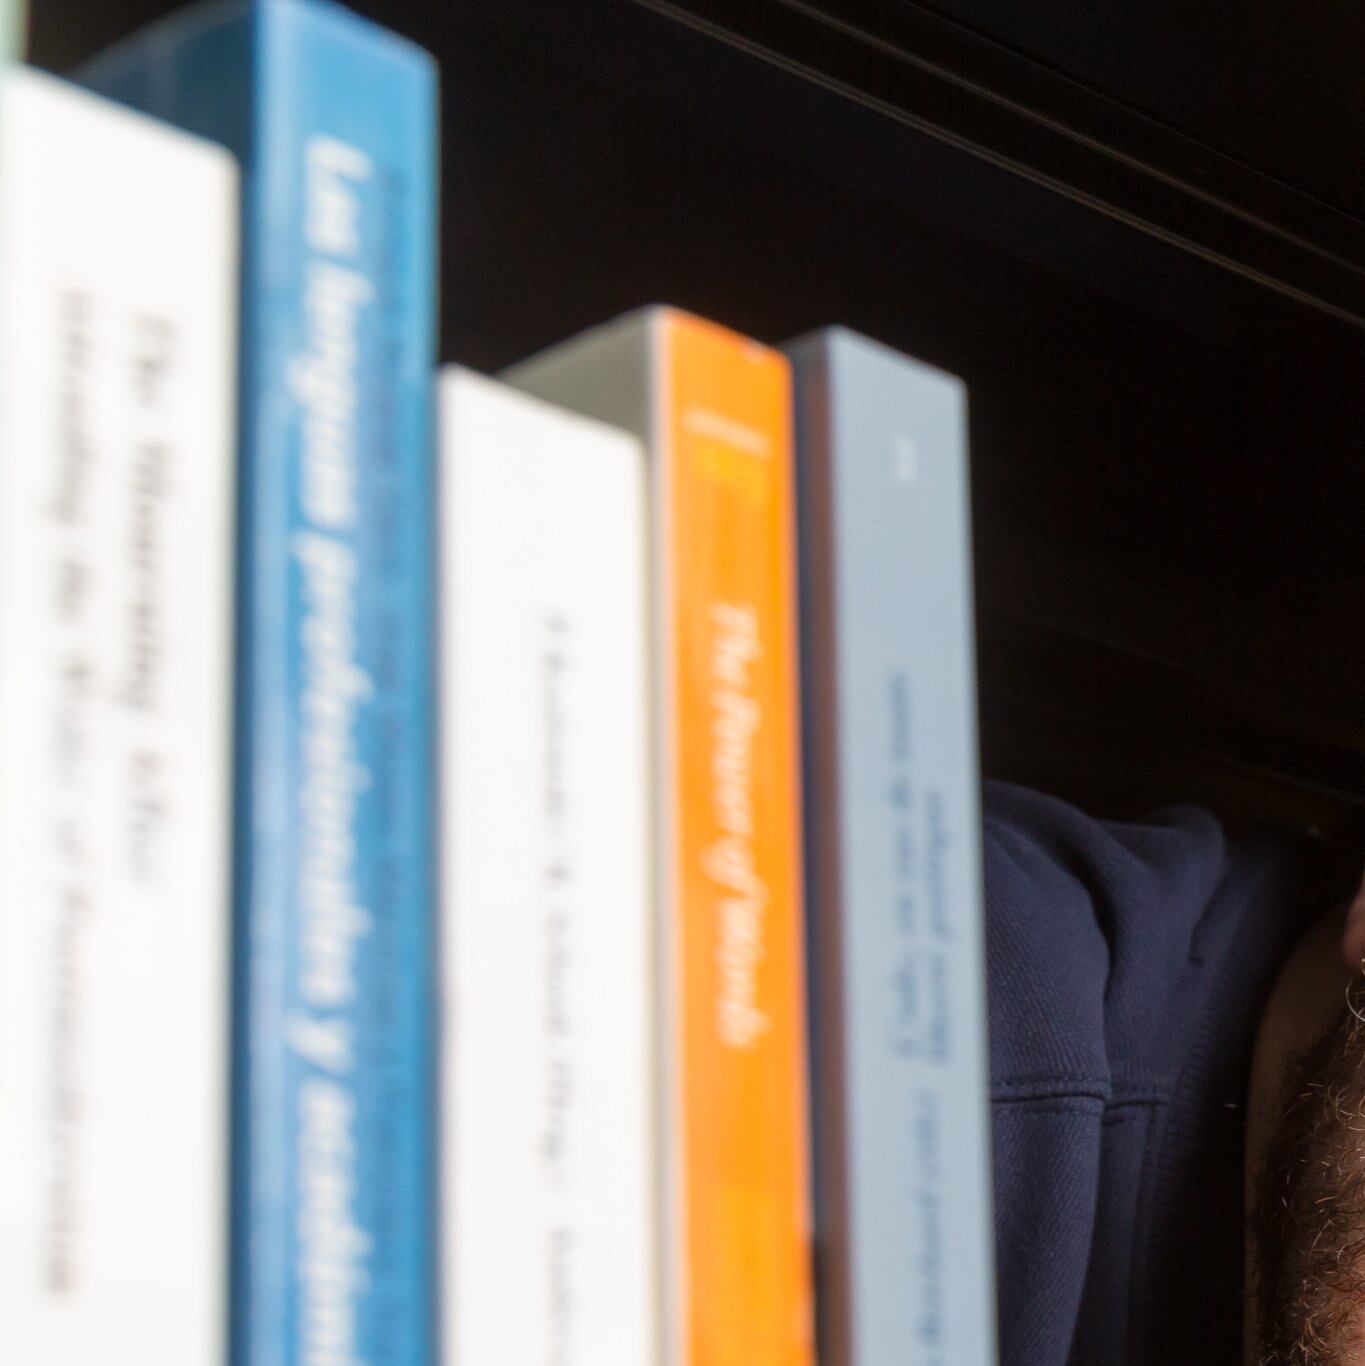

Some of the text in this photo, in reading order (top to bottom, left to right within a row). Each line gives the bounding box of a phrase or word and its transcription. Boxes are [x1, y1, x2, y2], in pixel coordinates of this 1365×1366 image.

[304, 138, 372, 256] Las
[287, 270, 372, 525] lenguas
[711, 603, 764, 685] The
[290, 530, 370, 1005] profesionales
[711, 690, 763, 832] Power
[285, 1008, 353, 1070] y
